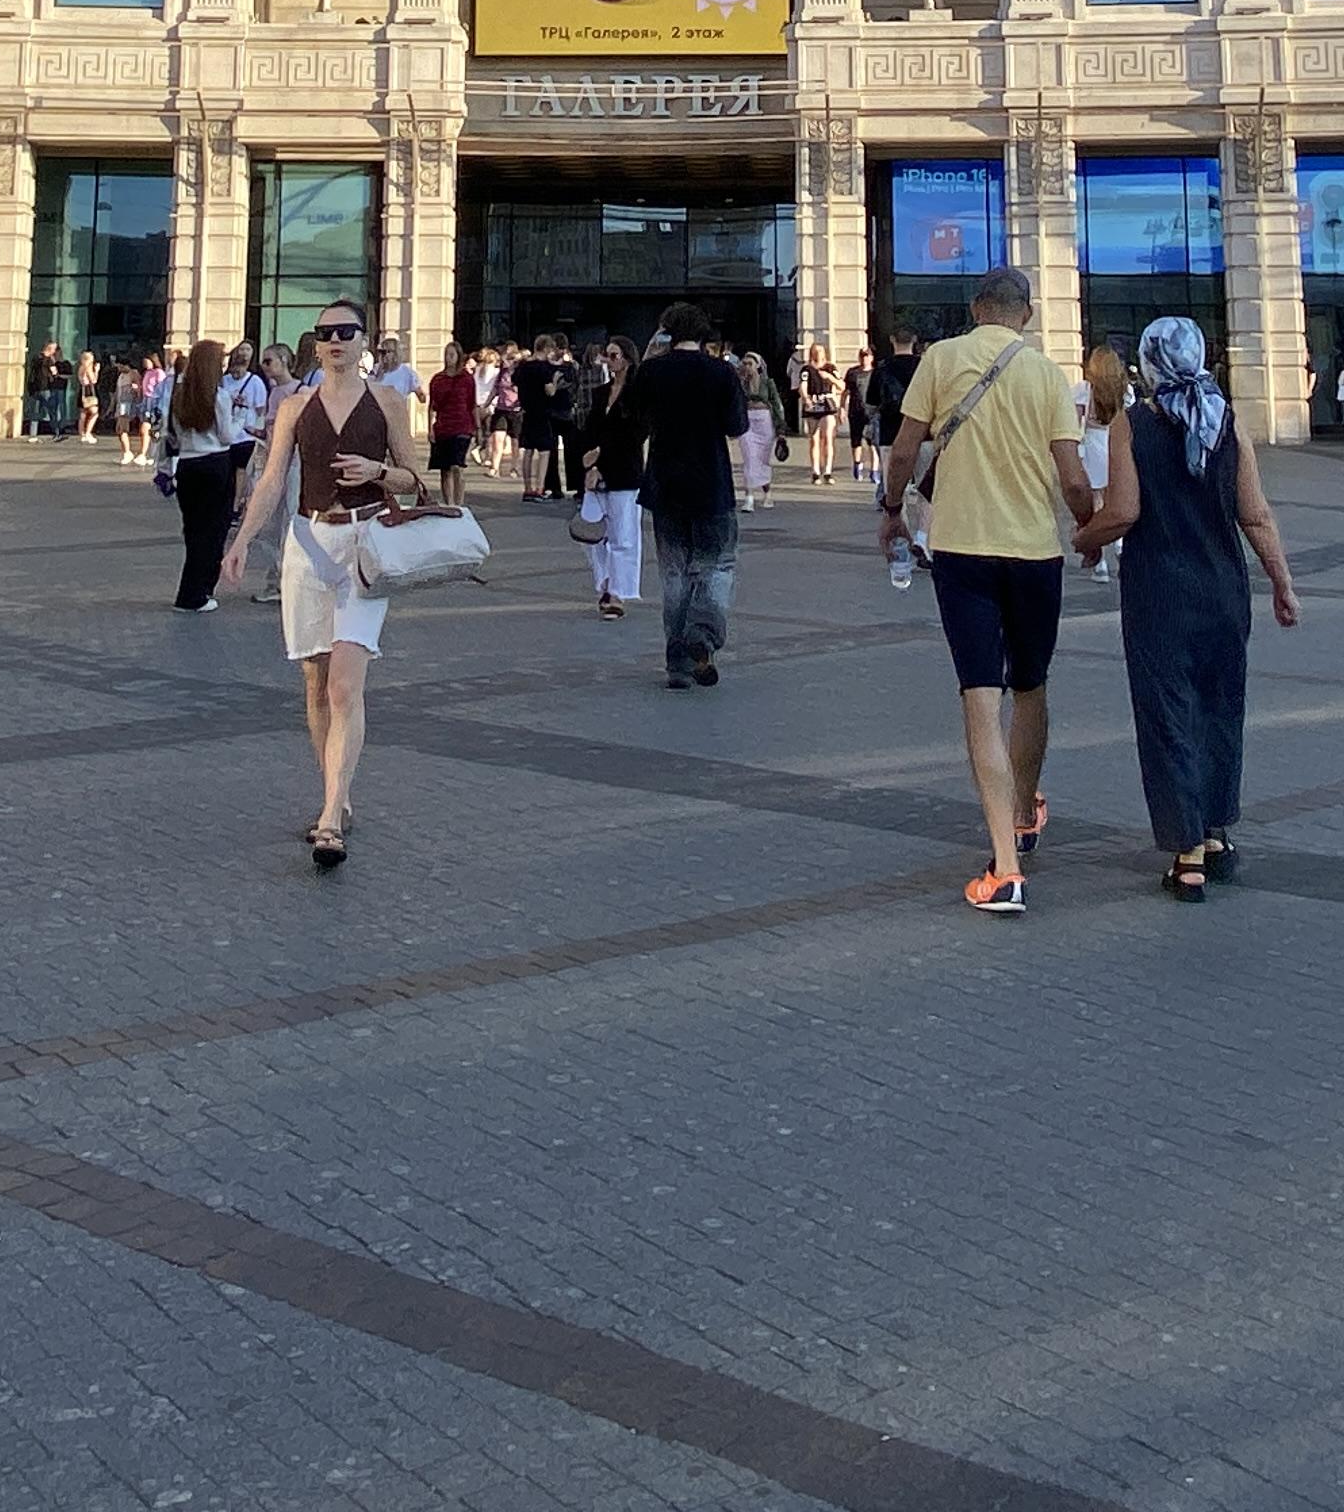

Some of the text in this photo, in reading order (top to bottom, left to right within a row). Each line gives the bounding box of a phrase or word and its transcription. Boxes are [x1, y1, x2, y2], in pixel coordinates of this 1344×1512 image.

[540, 27, 570, 41] ТРЦ
[671, 27, 682, 39] 2
[685, 29, 724, 39] этаж
[500, 74, 764, 117] ГАЛЕРЕЯ
